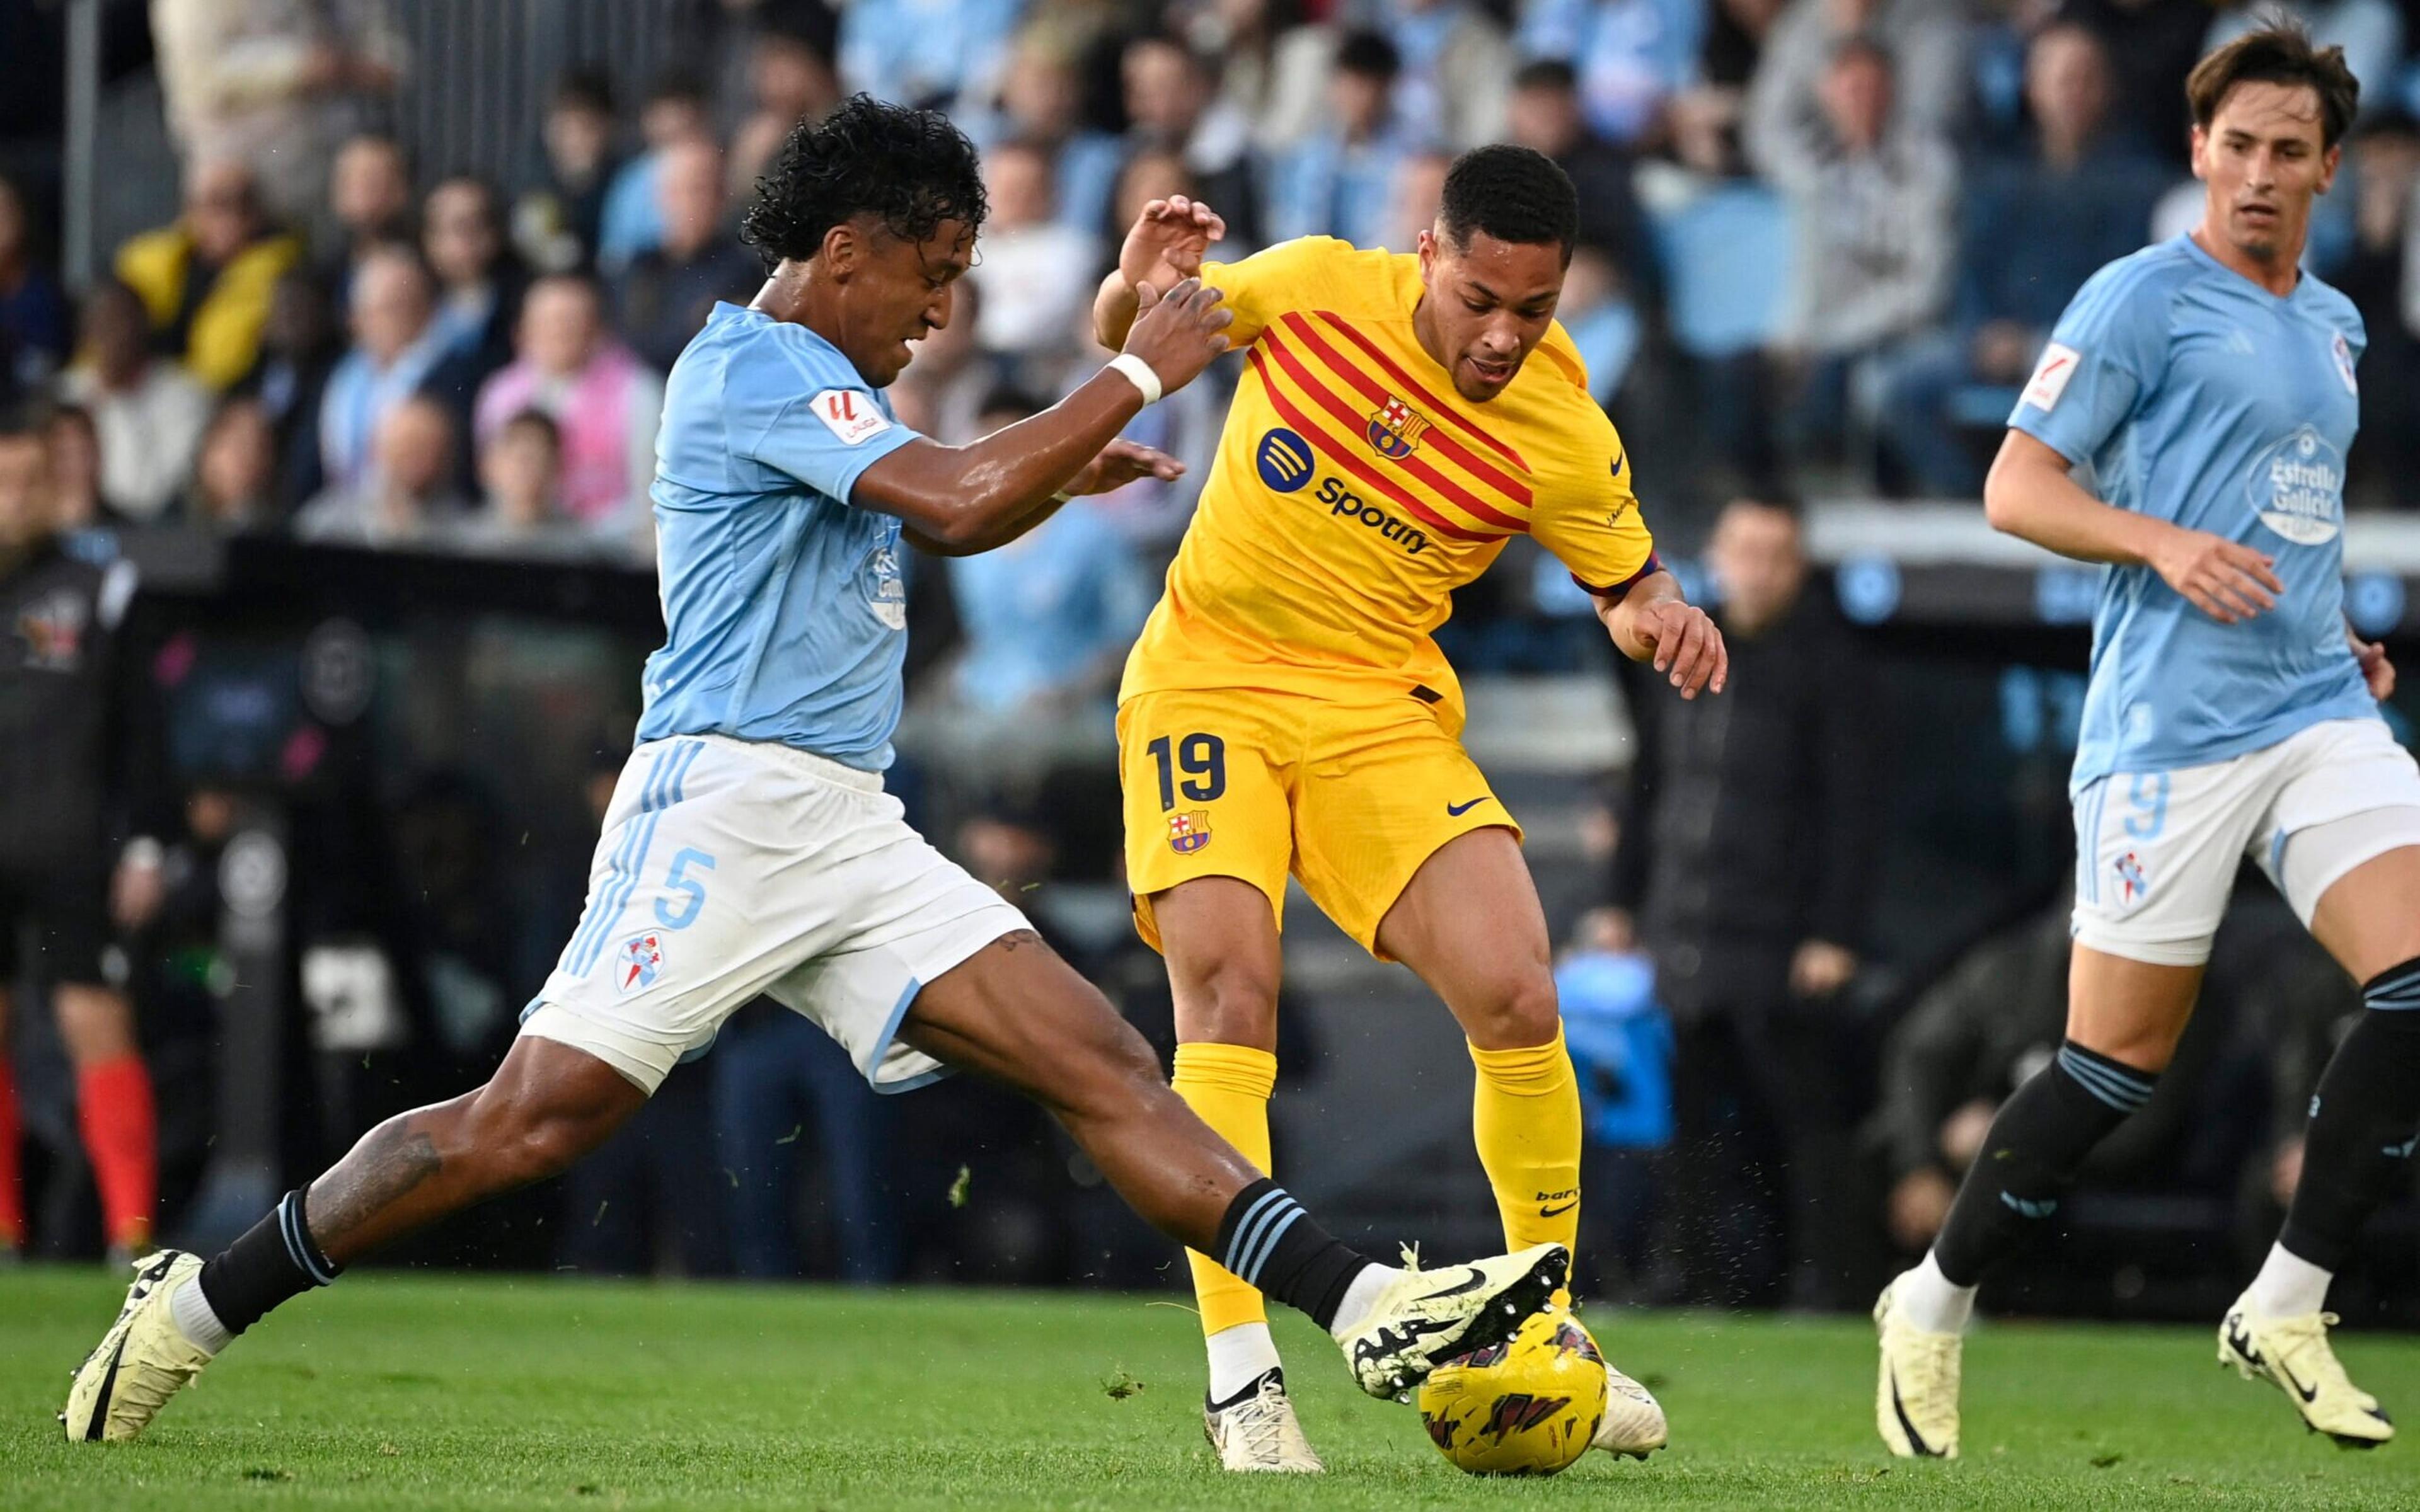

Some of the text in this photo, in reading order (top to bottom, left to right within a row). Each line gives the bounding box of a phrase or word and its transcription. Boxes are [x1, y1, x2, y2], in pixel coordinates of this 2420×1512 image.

[2269, 455, 2337, 492] Estrella
[2272, 483, 2332, 519] Galicia
[1315, 476, 1433, 554] Spotify
[1146, 732, 1226, 813] 19
[2124, 772, 2170, 840] 9
[654, 847, 716, 930] 5
